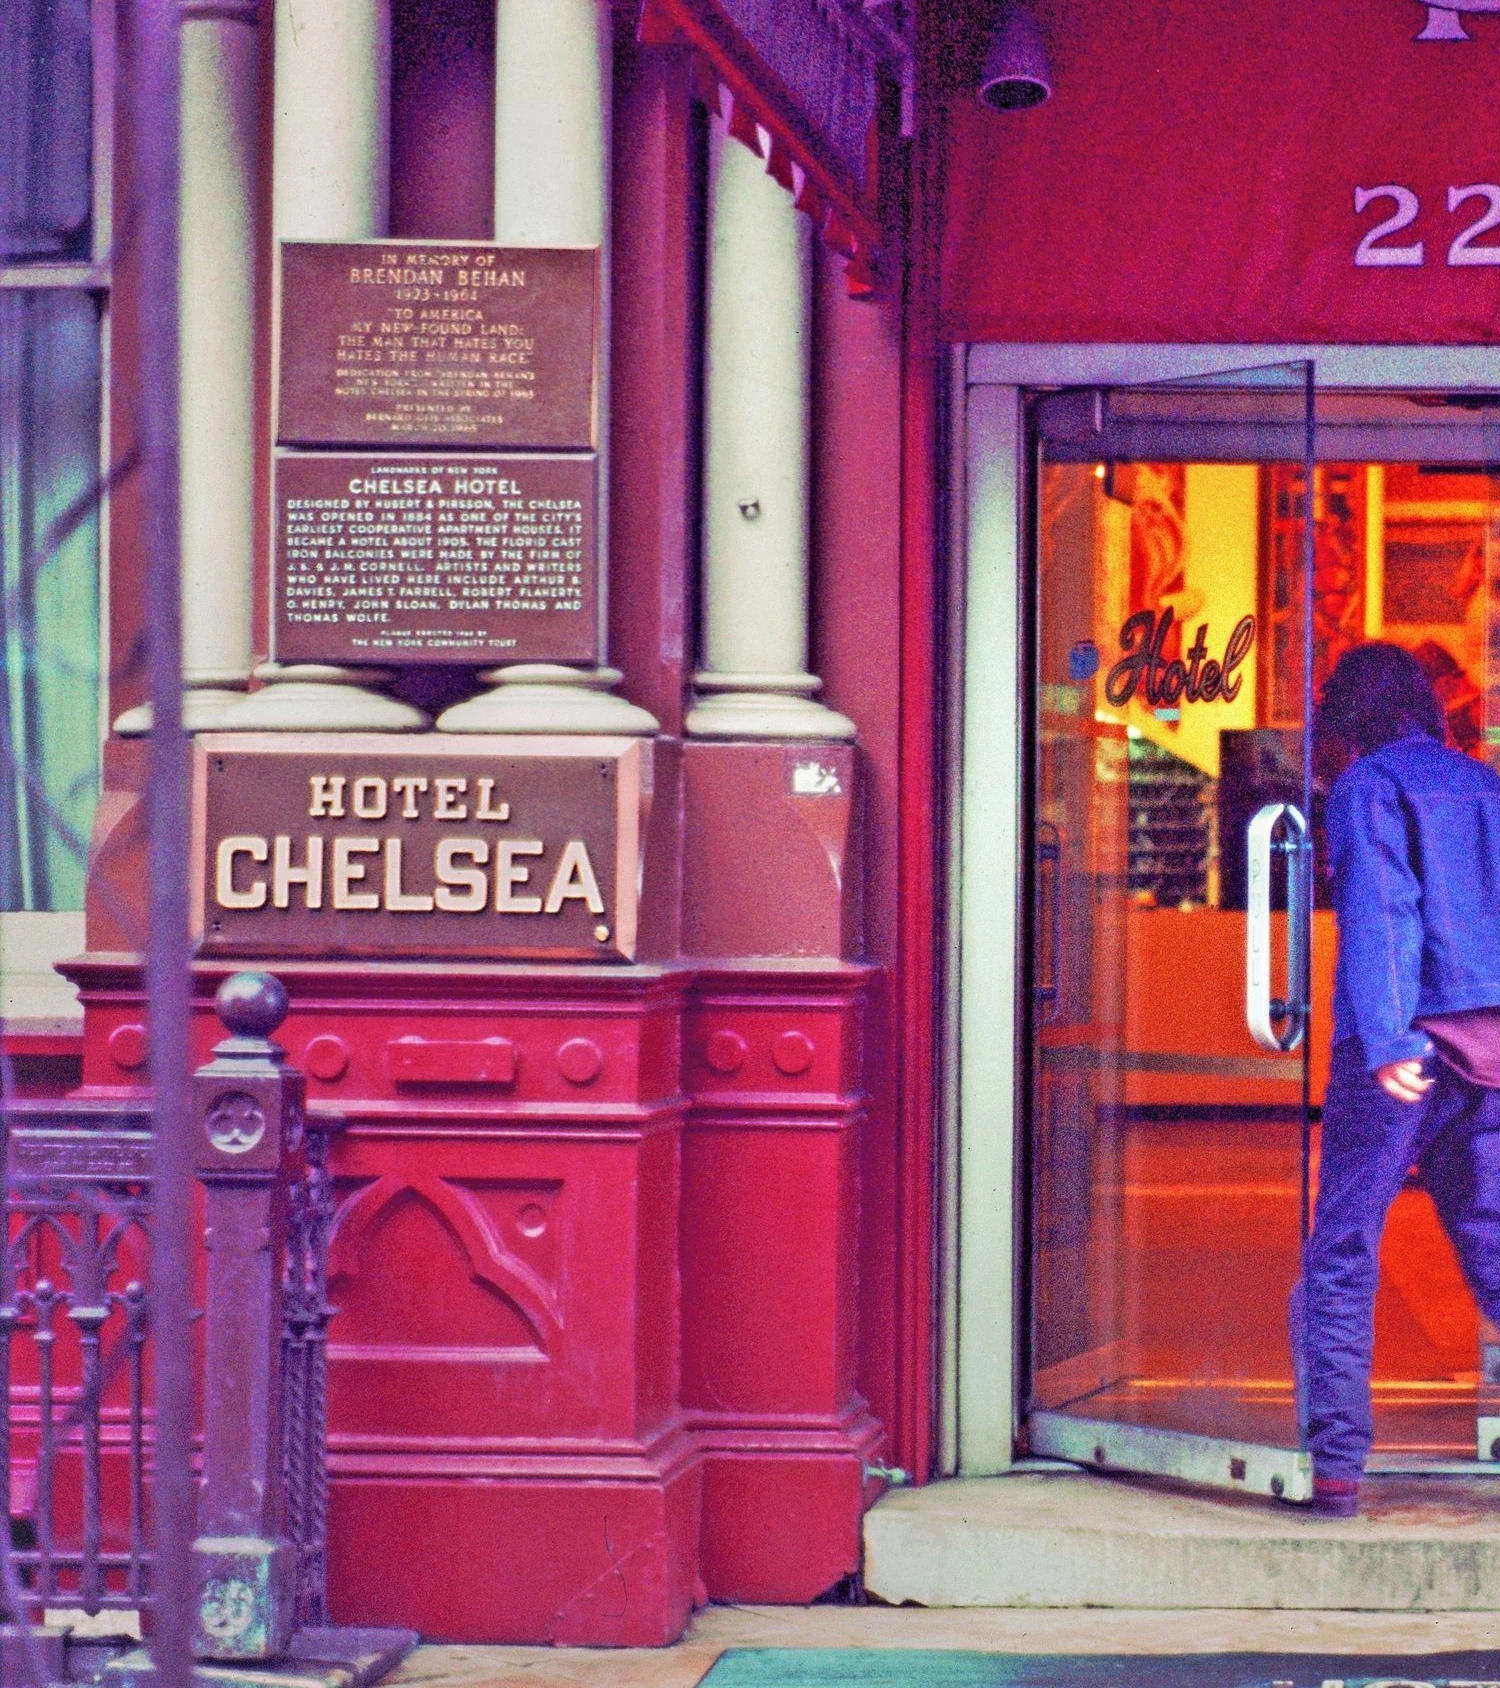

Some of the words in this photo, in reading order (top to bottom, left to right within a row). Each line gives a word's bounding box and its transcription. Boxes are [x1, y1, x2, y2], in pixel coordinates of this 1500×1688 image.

[406, 254, 470, 267] MEMORY
[475, 255, 496, 267] OF
[350, 268, 443, 285] BRENDAN
[458, 270, 526, 287] BEHAN
[420, 308, 483, 321] AMERICA
[339, 334, 365, 347] THE
[372, 335, 404, 348] MAN
[411, 336, 447, 348] THAT
[454, 337, 498, 350] HATES
[504, 338, 535, 351] YOU
[336, 349, 382, 362] HATES
[390, 350, 418, 362] THE
[425, 351, 481, 364] HUMAN
[371, 465, 427, 474] LANDMARKS
[431, 465, 443, 474] OF
[447, 465, 468, 474] NEW
[472, 465, 498, 474] YORK
[349, 479, 442, 495] CHELSEA
[454, 479, 522, 495] HOTEL
[287, 499, 349, 509] DESIGNED
[355, 499, 370, 509] BY
[375, 499, 421, 509] HUBERT
[503, 499, 523, 509] THE
[529, 499, 582, 509] CHELSEA
[287, 512, 314, 522] WAS
[321, 512, 374, 522] OPENED
[381, 512, 395, 522] IN
[403, 512, 432, 522] 1884
[438, 512, 454, 522] AS
[460, 512, 486, 522] ONE
[493, 512, 509, 522] OF
[515, 512, 536, 522] THE
[542, 512, 582, 522] CITY'S
[287, 524, 343, 535] EARLIEST
[349, 524, 432, 535] COOPERATIVE
[438, 524, 508, 535] APARTMENT
[569, 524, 582, 535] IT
[287, 537, 333, 547] BECAME
[338, 537, 346, 547] A
[351, 537, 388, 547] HOTEL
[393, 537, 432, 547] ABOUT
[476, 537, 497, 547] THE
[502, 537, 546, 547] FLORID
[552, 537, 582, 547] CAST
[287, 549, 318, 559] IRON
[324, 549, 394, 559] BALCONIES
[400, 549, 433, 559] WERE
[439, 549, 473, 559] MADE
[480, 549, 495, 559] BY
[500, 549, 523, 559] THE
[529, 549, 560, 559] FIRM
[566, 549, 581, 559] OF
[330, 562, 340, 572] J.
[435, 562, 488, 572] ARTISTS
[494, 562, 521, 572] AND
[526, 562, 582, 572] WRITERS
[287, 574, 316, 585] WHO
[324, 574, 356, 585] HAVE
[362, 574, 400, 585] LIVED
[407, 574, 440, 585] HERE
[447, 574, 505, 585] INCLUDE
[513, 574, 565, 585] ARTHUR
[342, 587, 383, 597] JAMES
[462, 587, 511, 597] ROBERT
[353, 599, 389, 609] JOHN
[449, 599, 489, 609] DYLAN
[495, 599, 546, 609] THOMAS
[555, 599, 582, 609] AND
[287, 612, 339, 623] THOMAS
[427, 638, 484, 647] COMMUNITY
[1104, 603, 1257, 706] Hotel
[308, 776, 511, 820] HOTEL
[216, 836, 605, 914] CHELSEA
